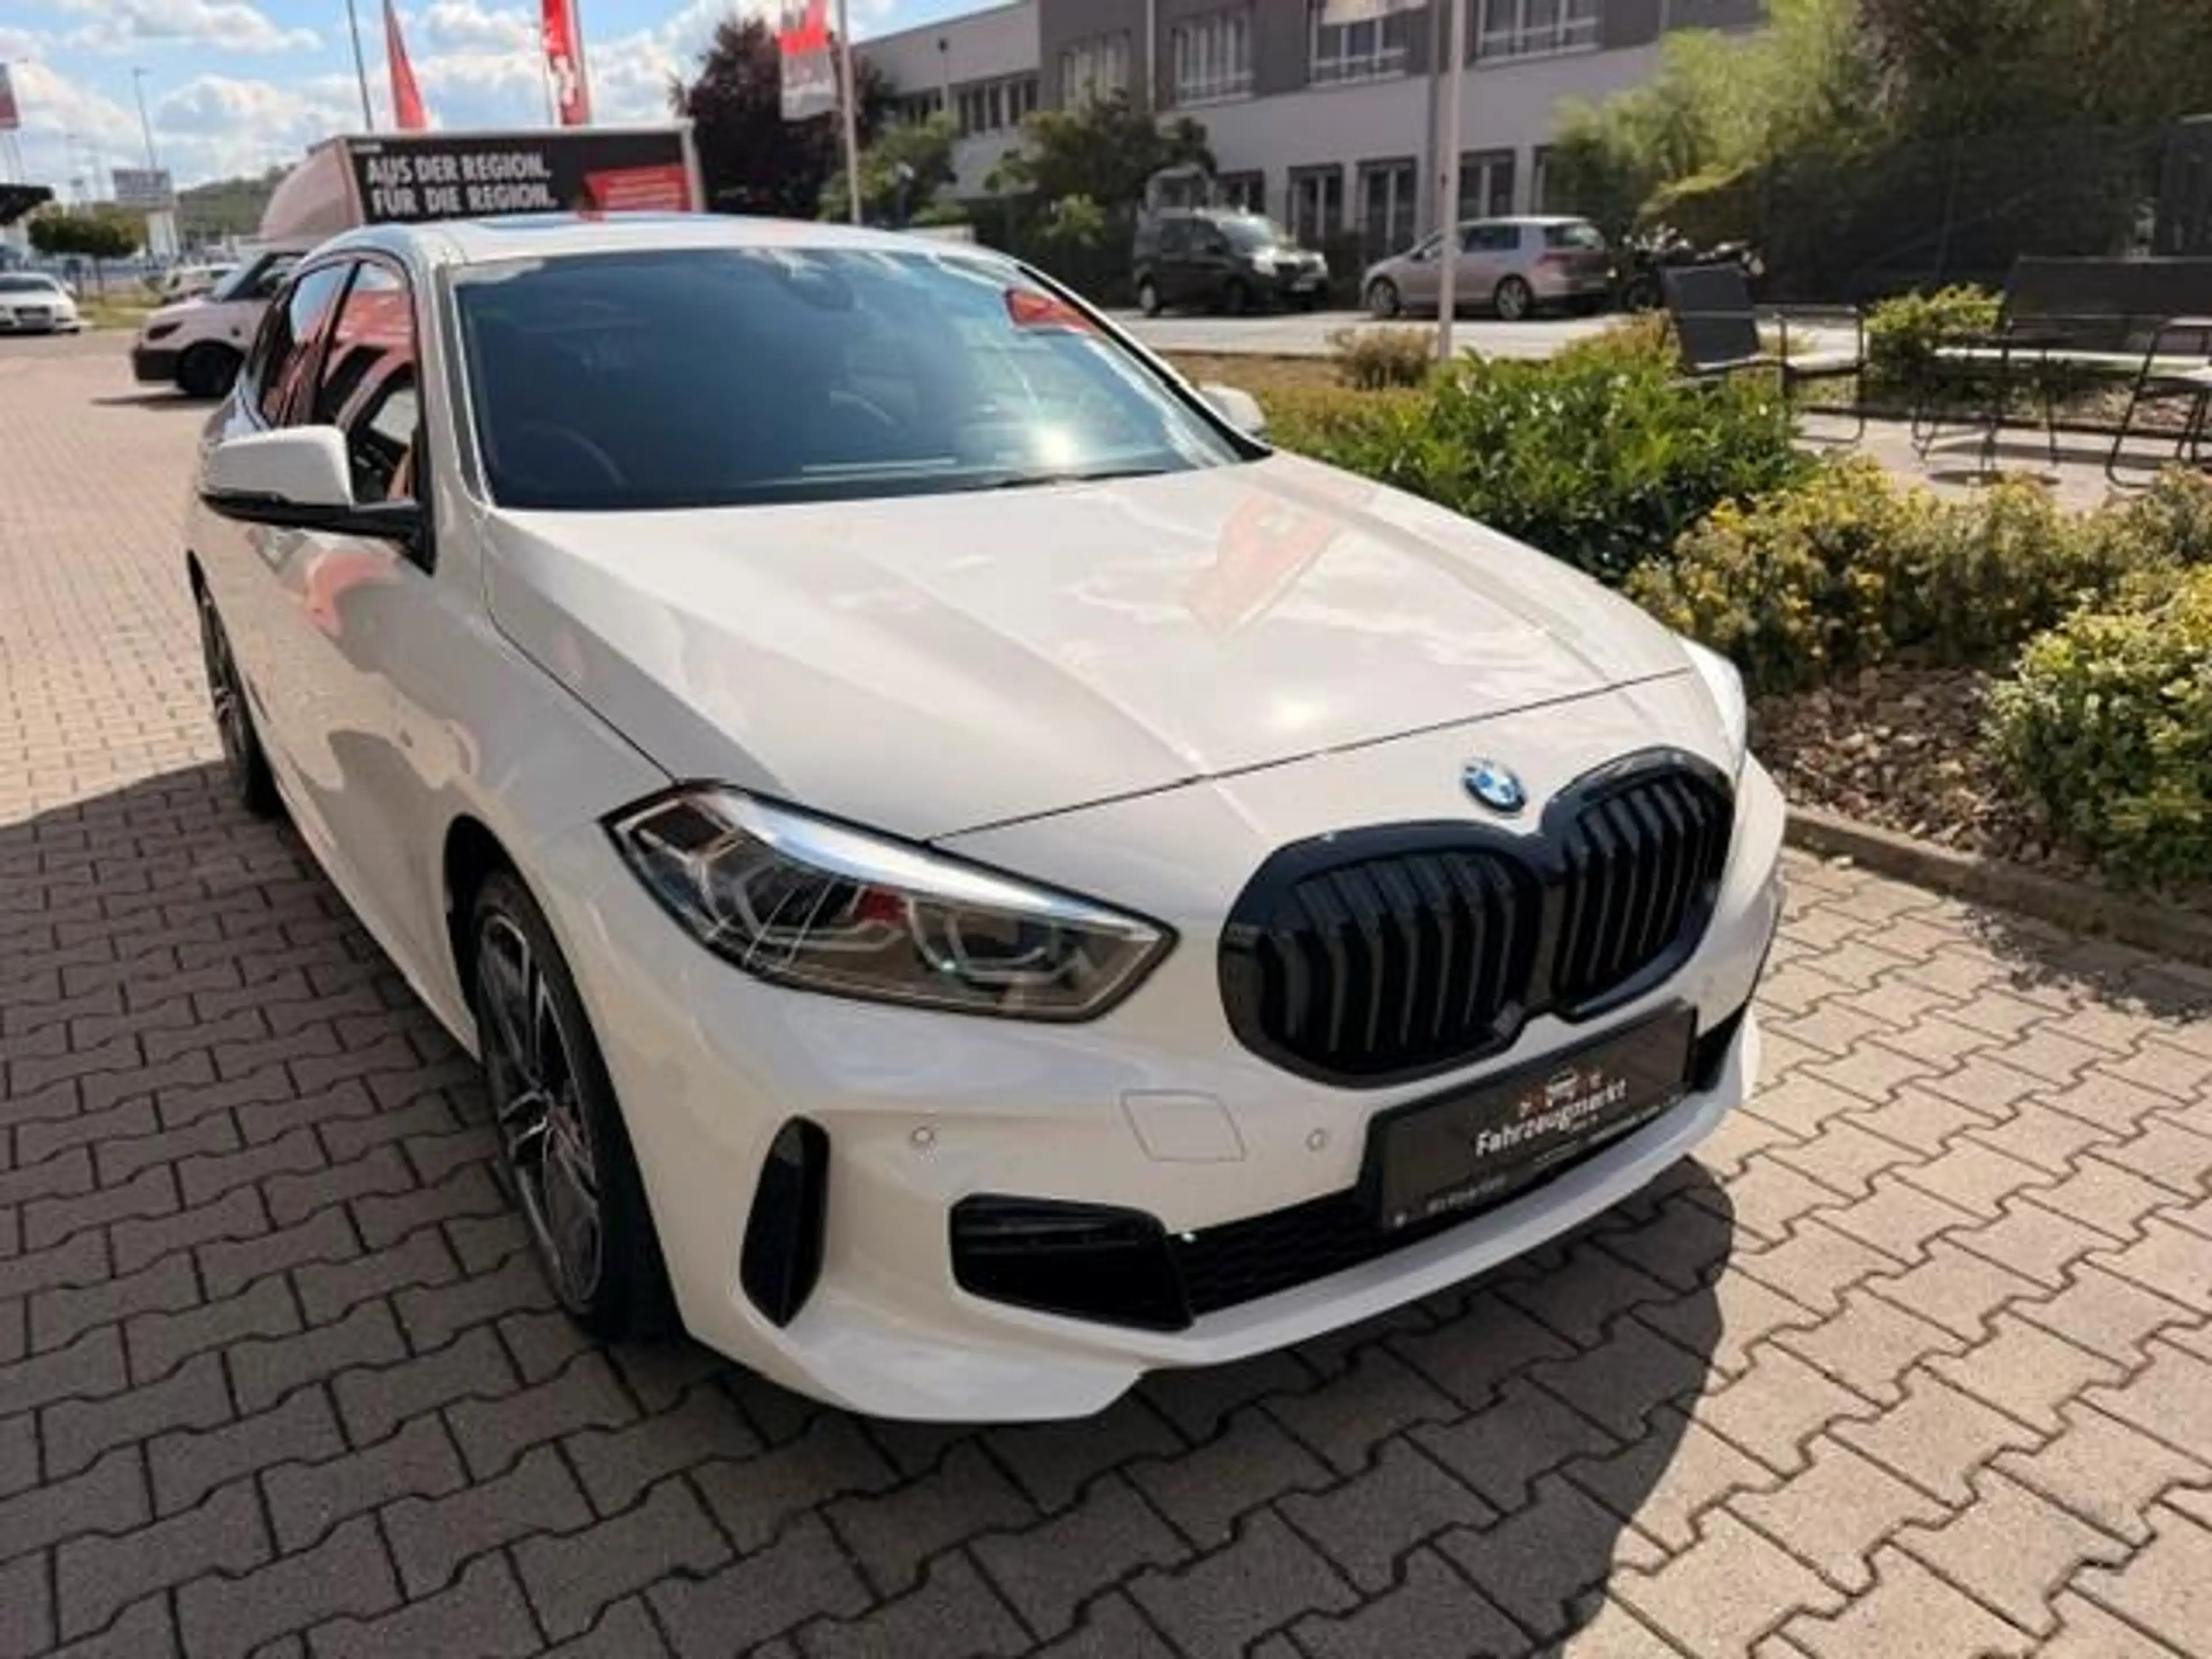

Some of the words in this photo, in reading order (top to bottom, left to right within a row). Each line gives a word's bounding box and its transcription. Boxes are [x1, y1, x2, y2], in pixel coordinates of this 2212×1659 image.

[368, 156, 412, 184] AUS
[414, 154, 460, 181] DER
[461, 153, 551, 180] REGION.
[371, 181, 419, 215] FÜR
[423, 185, 461, 213] DIE
[466, 183, 558, 211] REGION.
